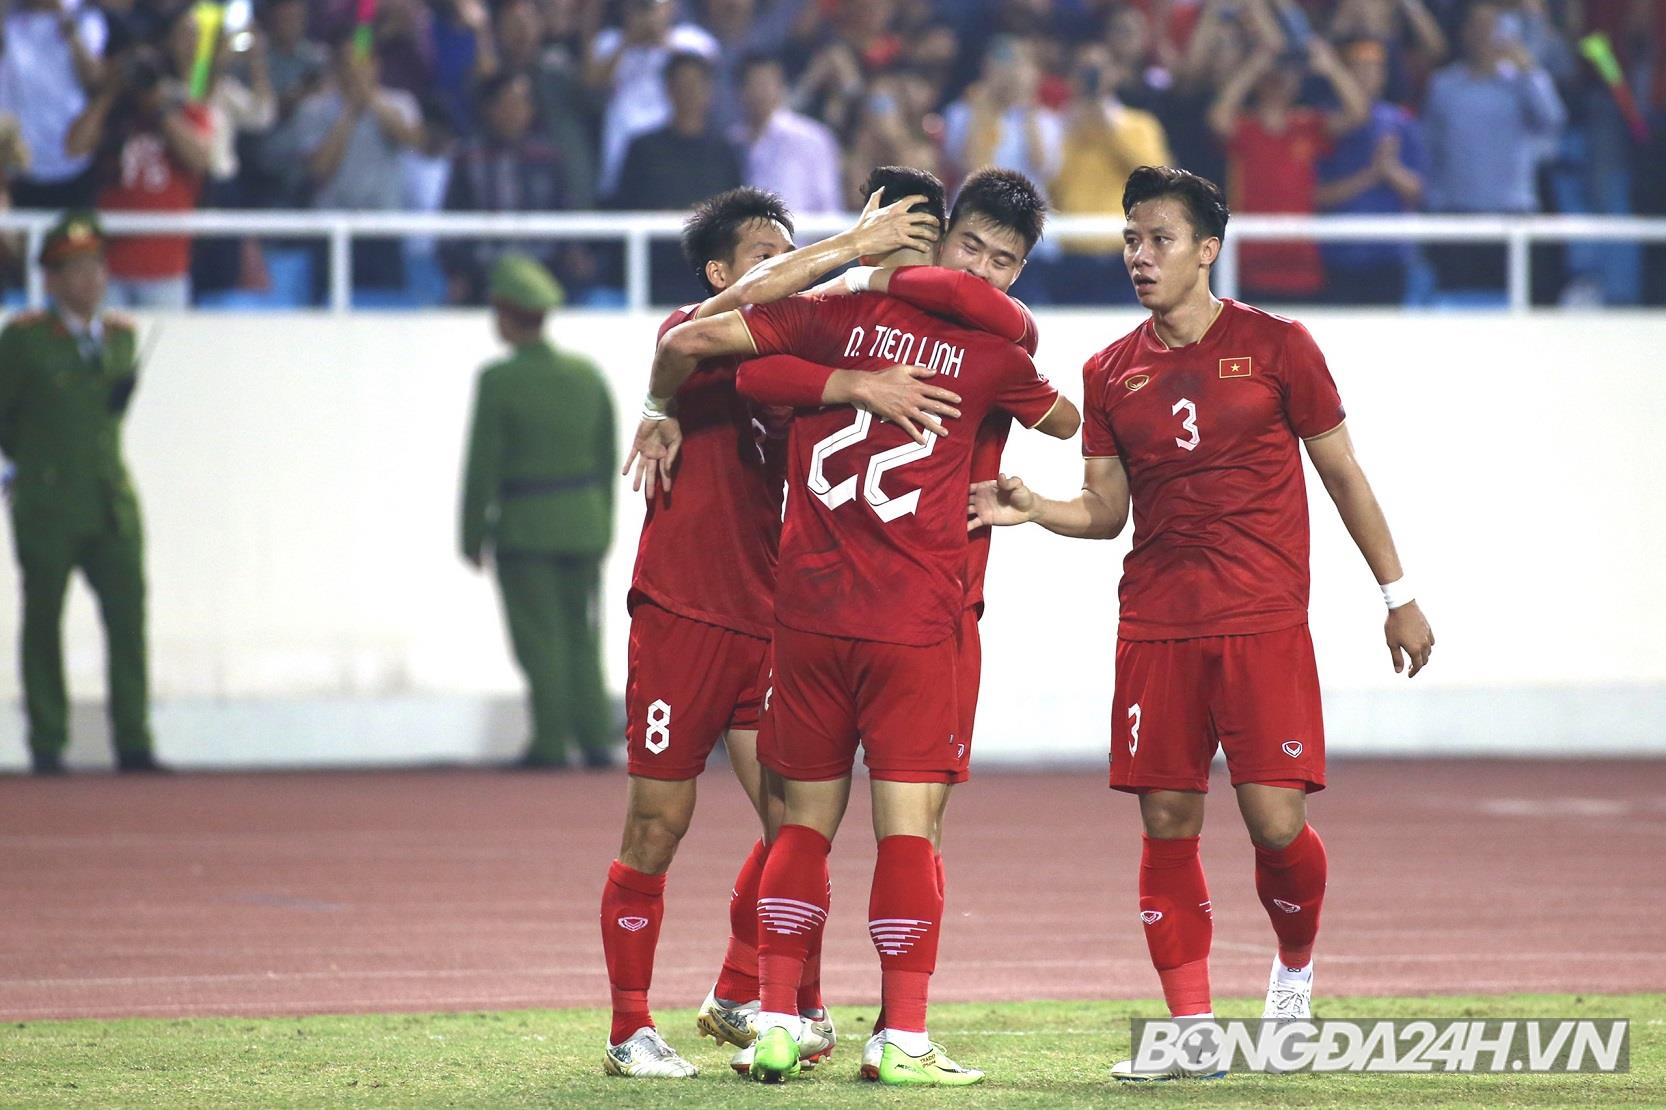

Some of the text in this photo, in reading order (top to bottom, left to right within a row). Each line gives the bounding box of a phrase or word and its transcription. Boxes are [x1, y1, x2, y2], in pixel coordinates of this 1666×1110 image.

[868, 325, 915, 365] TIEN
[914, 336, 965, 378] LINH
[1172, 398, 1200, 451] 3
[807, 397, 943, 523] 22
[645, 698, 671, 755] 8
[1127, 703, 1141, 757] 3
